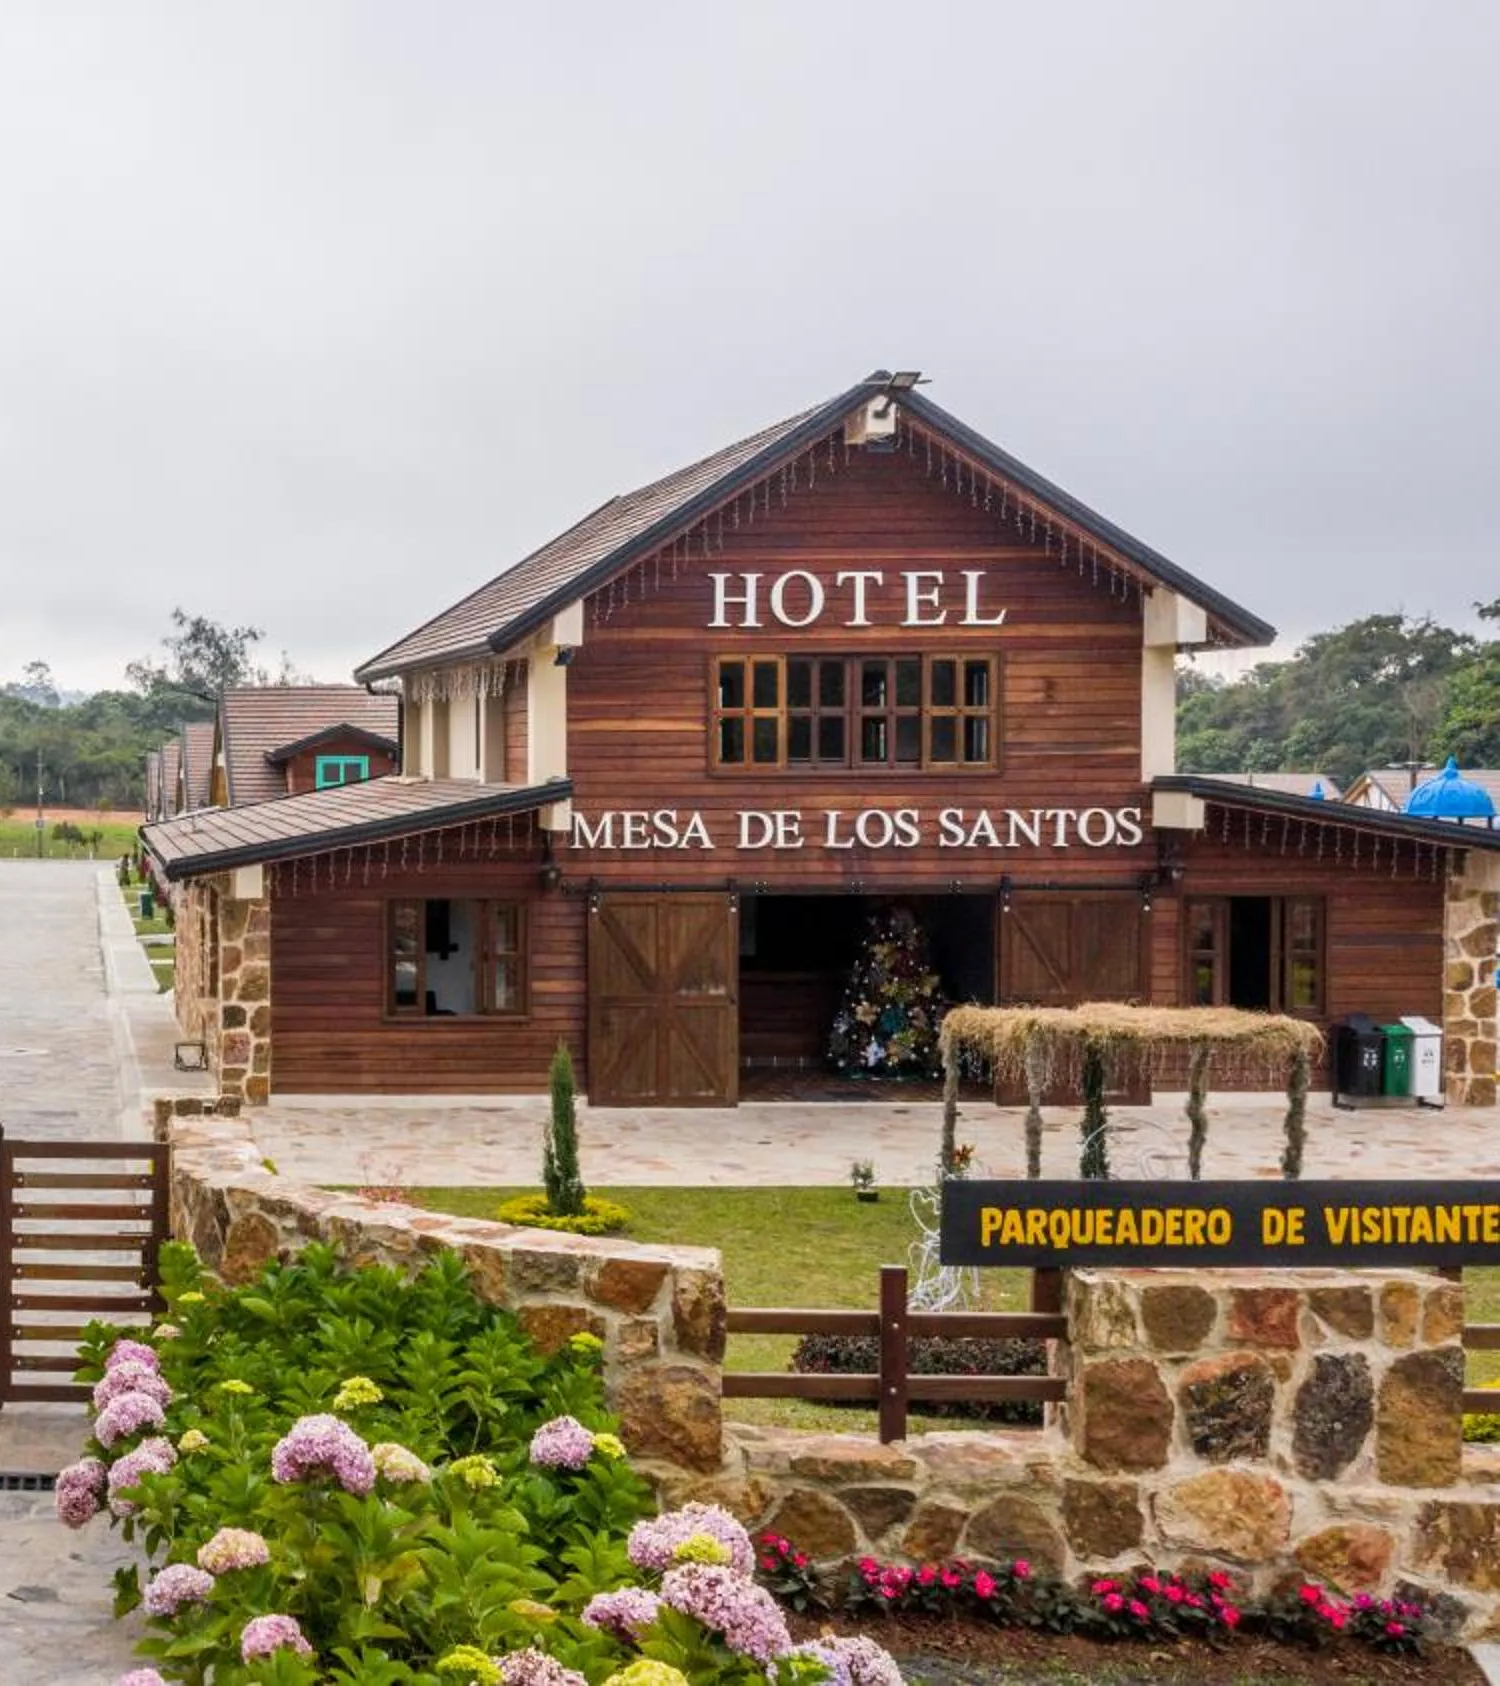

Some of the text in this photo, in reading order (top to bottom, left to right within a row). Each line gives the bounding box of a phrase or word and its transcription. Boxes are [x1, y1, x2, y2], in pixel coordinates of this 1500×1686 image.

[707, 570, 1007, 627] HOTEL
[570, 807, 1144, 850] MESA DE LOS SANTOS
[980, 1204, 1500, 1248] PARQUEADERO DE VISITANTE
